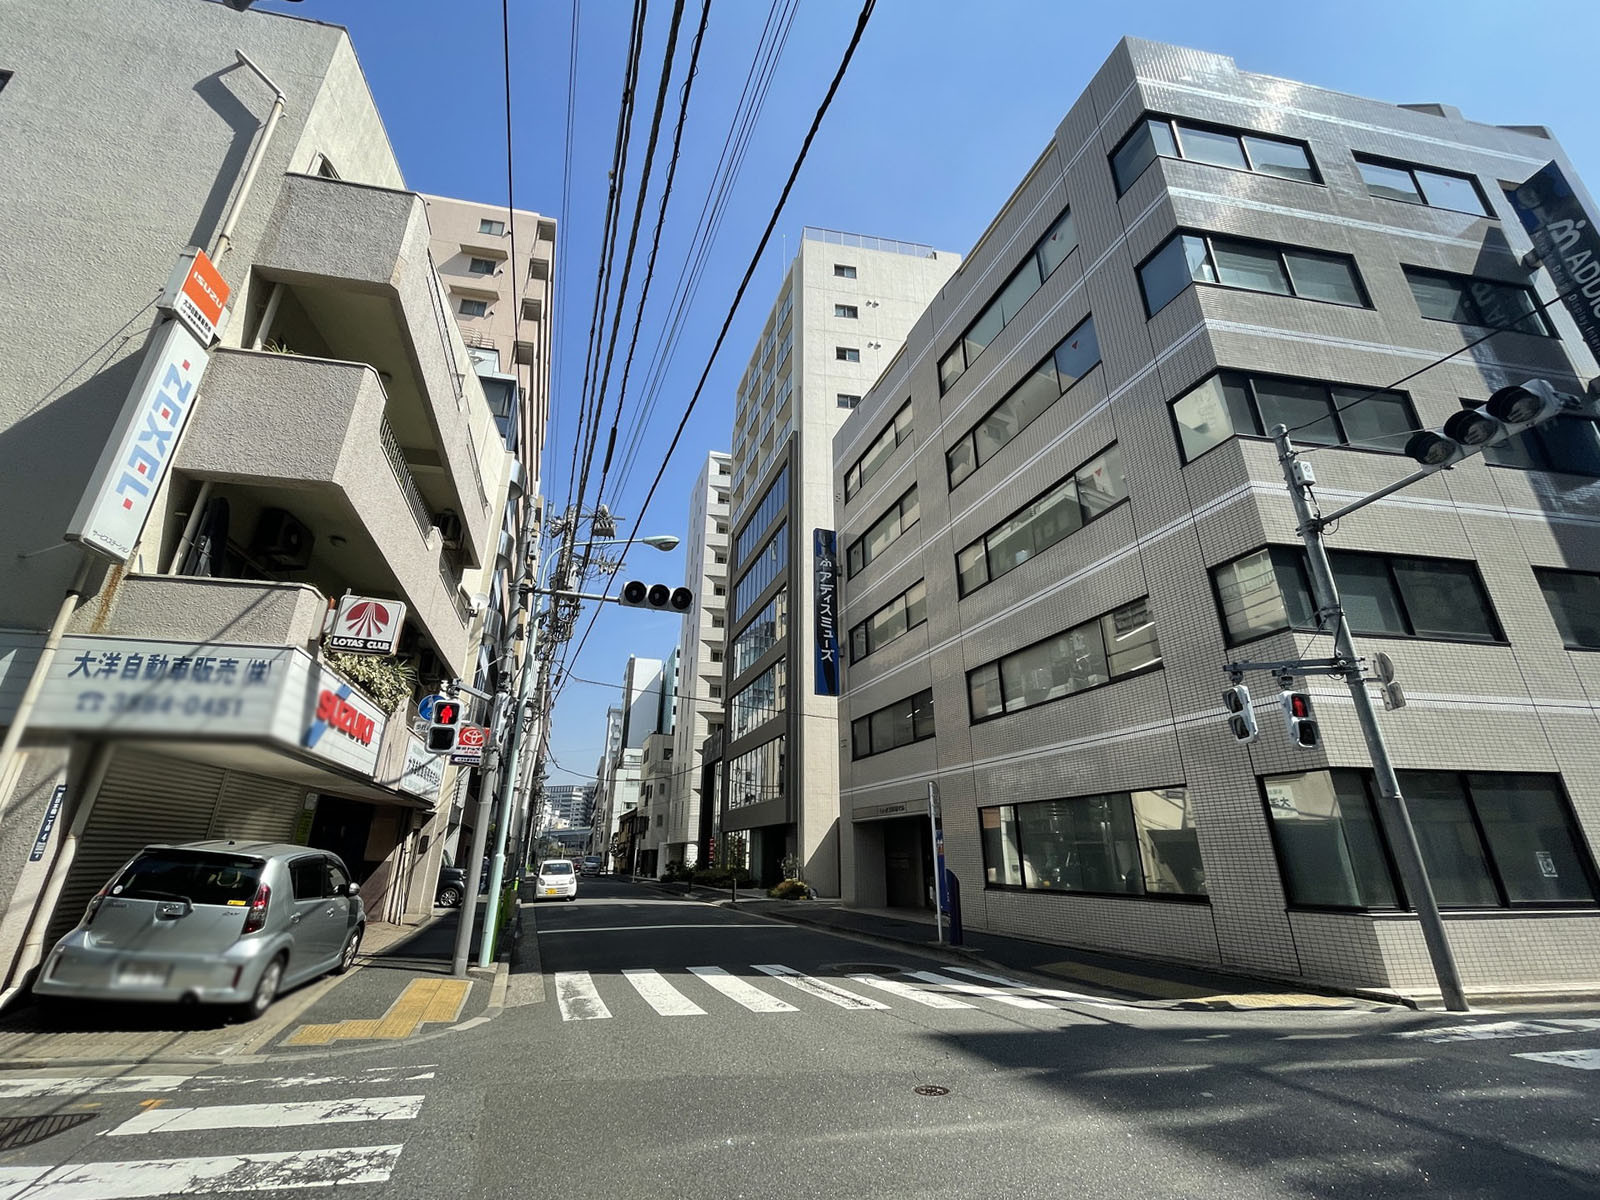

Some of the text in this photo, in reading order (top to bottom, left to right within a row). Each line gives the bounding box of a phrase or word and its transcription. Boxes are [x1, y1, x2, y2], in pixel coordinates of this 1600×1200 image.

[194, 270, 224, 310] ISUZU
[115, 362, 193, 498] ZEXEL
[332, 637, 390, 651] LOTAS CLUB
[819, 570, 835, 662] アディスミューズ
[316, 689, 376, 747] SUZUKI
